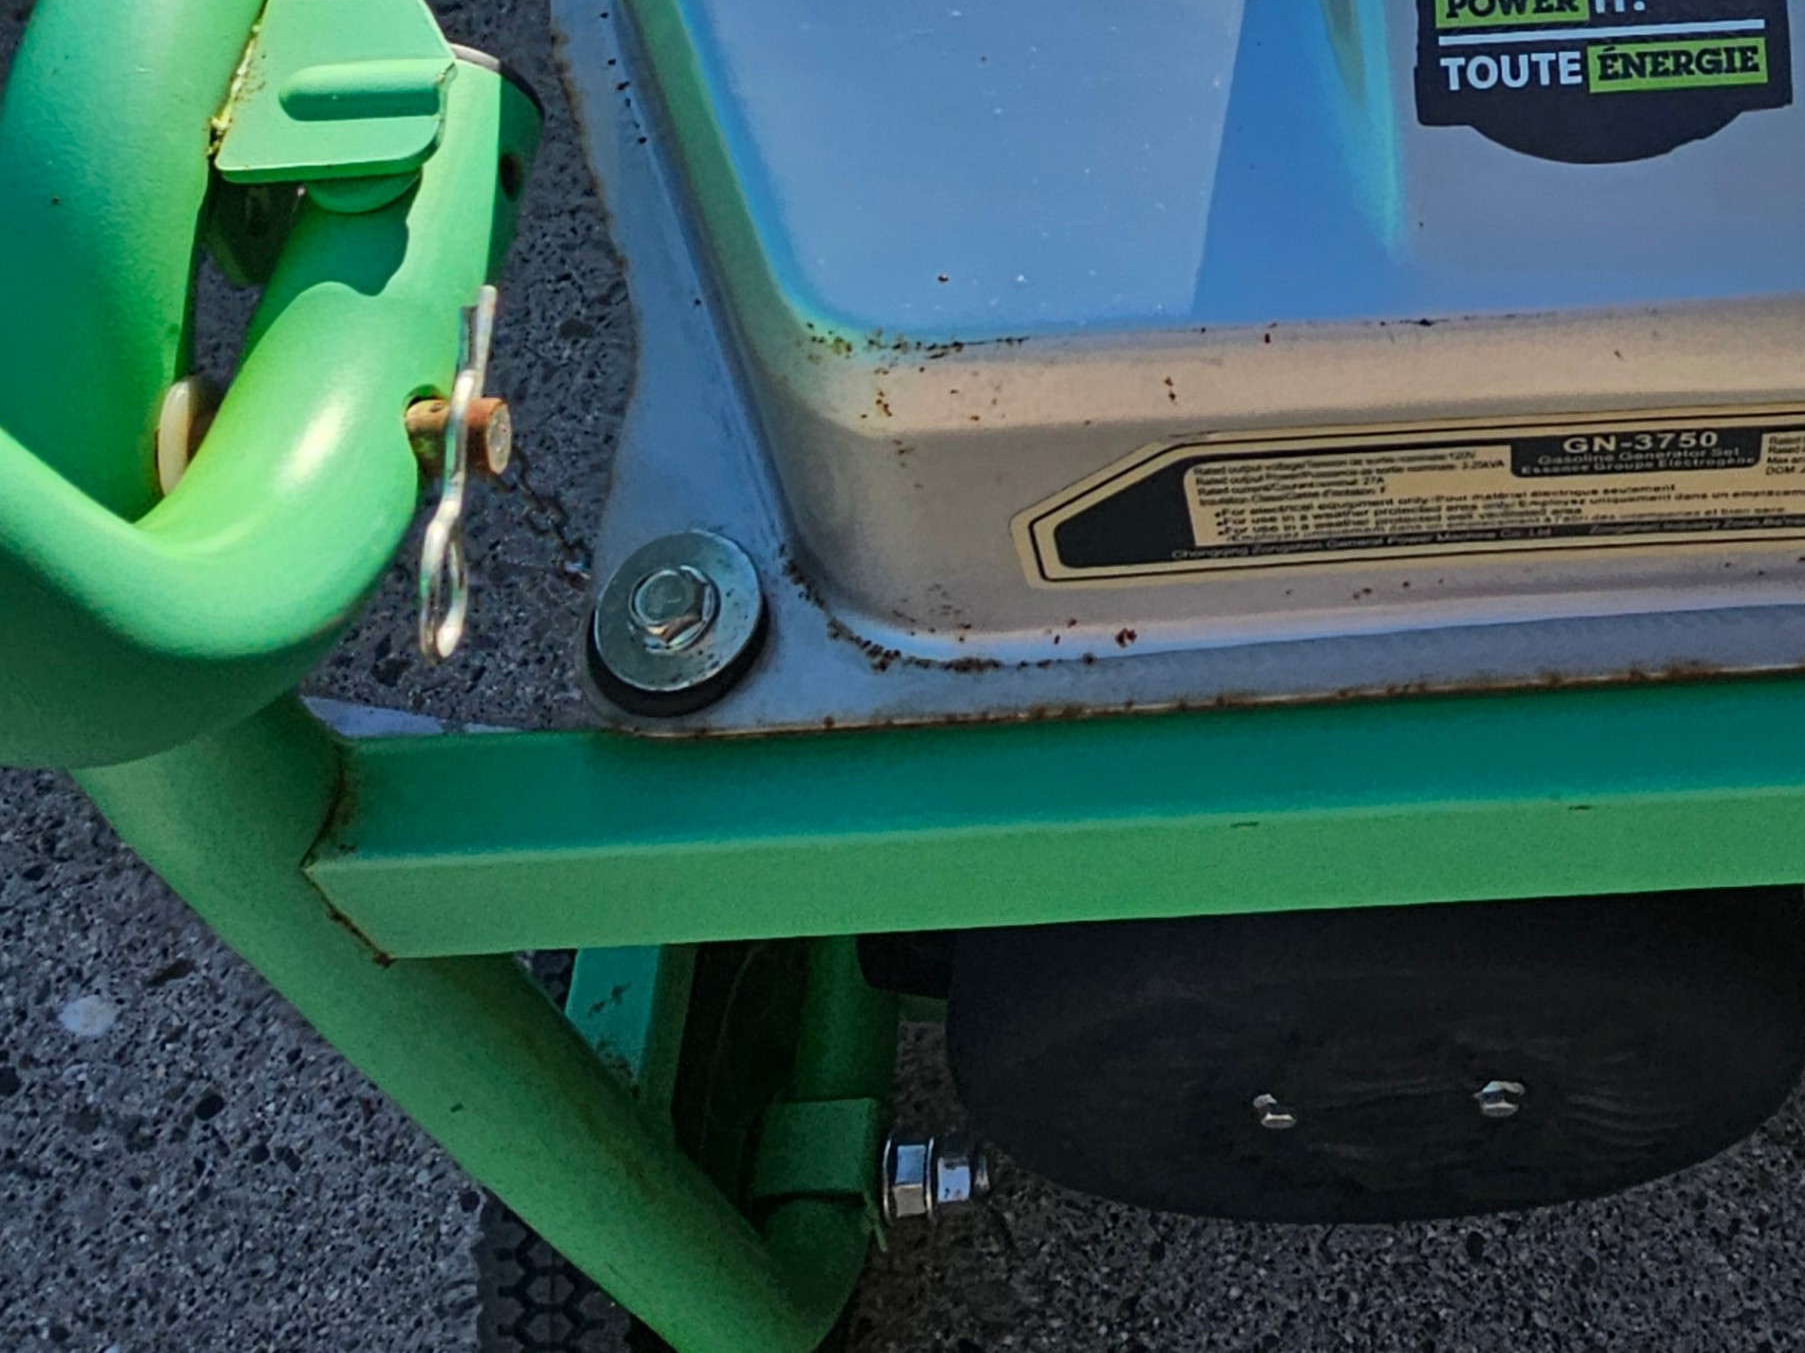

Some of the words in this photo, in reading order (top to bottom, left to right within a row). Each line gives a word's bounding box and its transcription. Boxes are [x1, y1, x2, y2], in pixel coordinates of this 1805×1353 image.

[1440, 50, 1582, 91] TOUTE
[1597, 45, 1760, 82] ÉNERGIE
[1563, 431, 1718, 453] GN-3750
[1537, 453, 1615, 466] Gasoline
[1619, 450, 1706, 461] Generator
[1711, 447, 1739, 457] Set
[1522, 463, 1590, 475] Essence
[1594, 461, 1654, 472] Groupe
[1221, 508, 1245, 517] For
[1251, 516, 1277, 524] use
